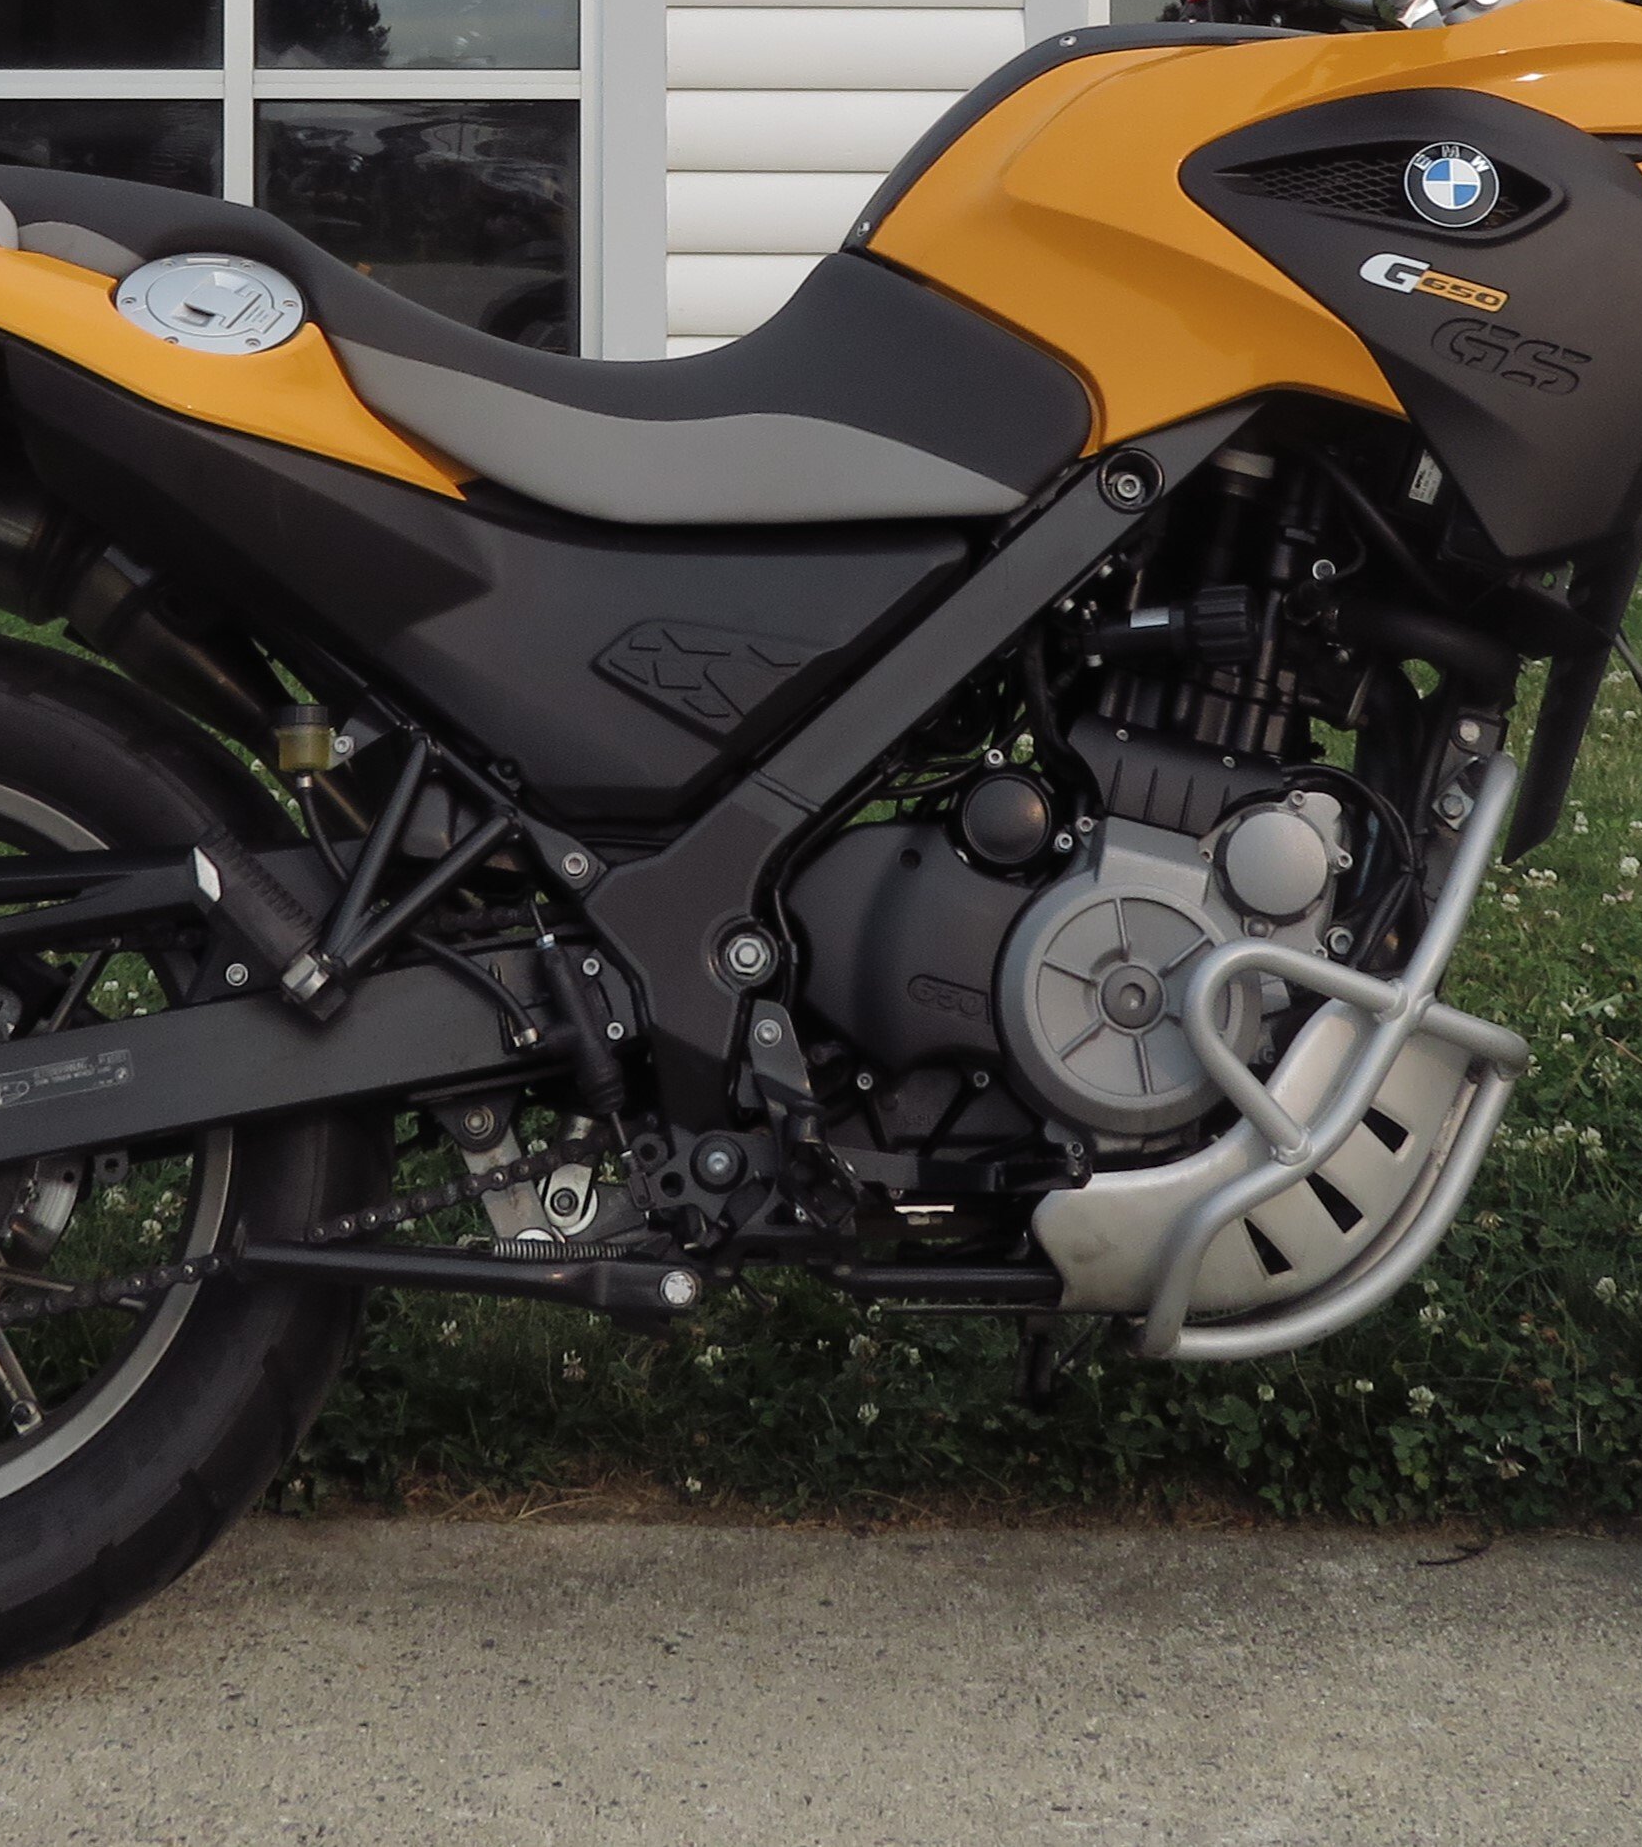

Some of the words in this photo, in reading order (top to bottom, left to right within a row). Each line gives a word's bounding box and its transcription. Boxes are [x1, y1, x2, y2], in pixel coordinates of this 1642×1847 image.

[1413, 144, 1490, 174] BMW
[1431, 317, 1593, 395] GS
[912, 981, 985, 1019] 650
